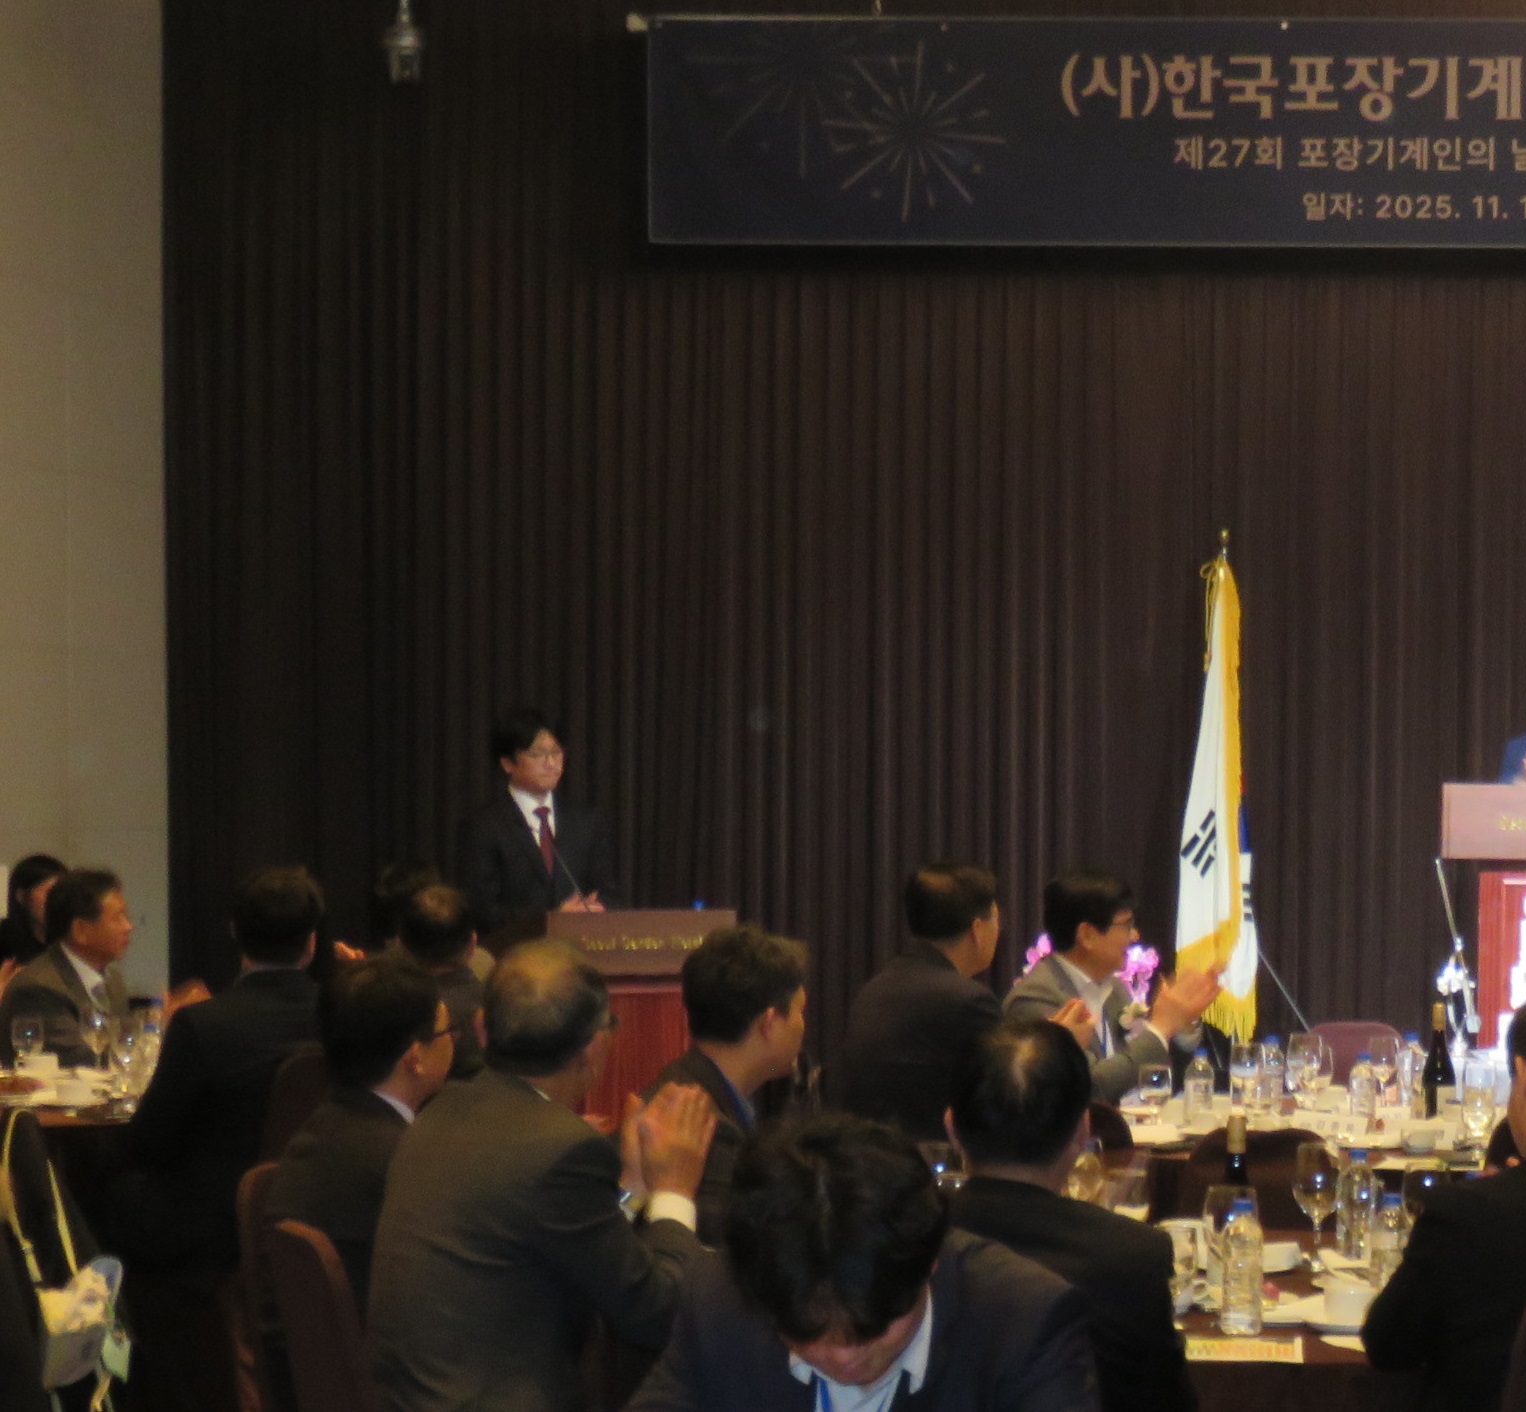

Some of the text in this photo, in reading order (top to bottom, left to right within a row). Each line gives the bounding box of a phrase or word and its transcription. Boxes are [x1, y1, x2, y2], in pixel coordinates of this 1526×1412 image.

[1174, 136, 1283, 170] 제27회
[1299, 138, 1495, 171] 포장기계인의
[1303, 192, 1363, 220] 일자:
[1376, 194, 1460, 219] 2025.
[1472, 196, 1508, 219] 11.
